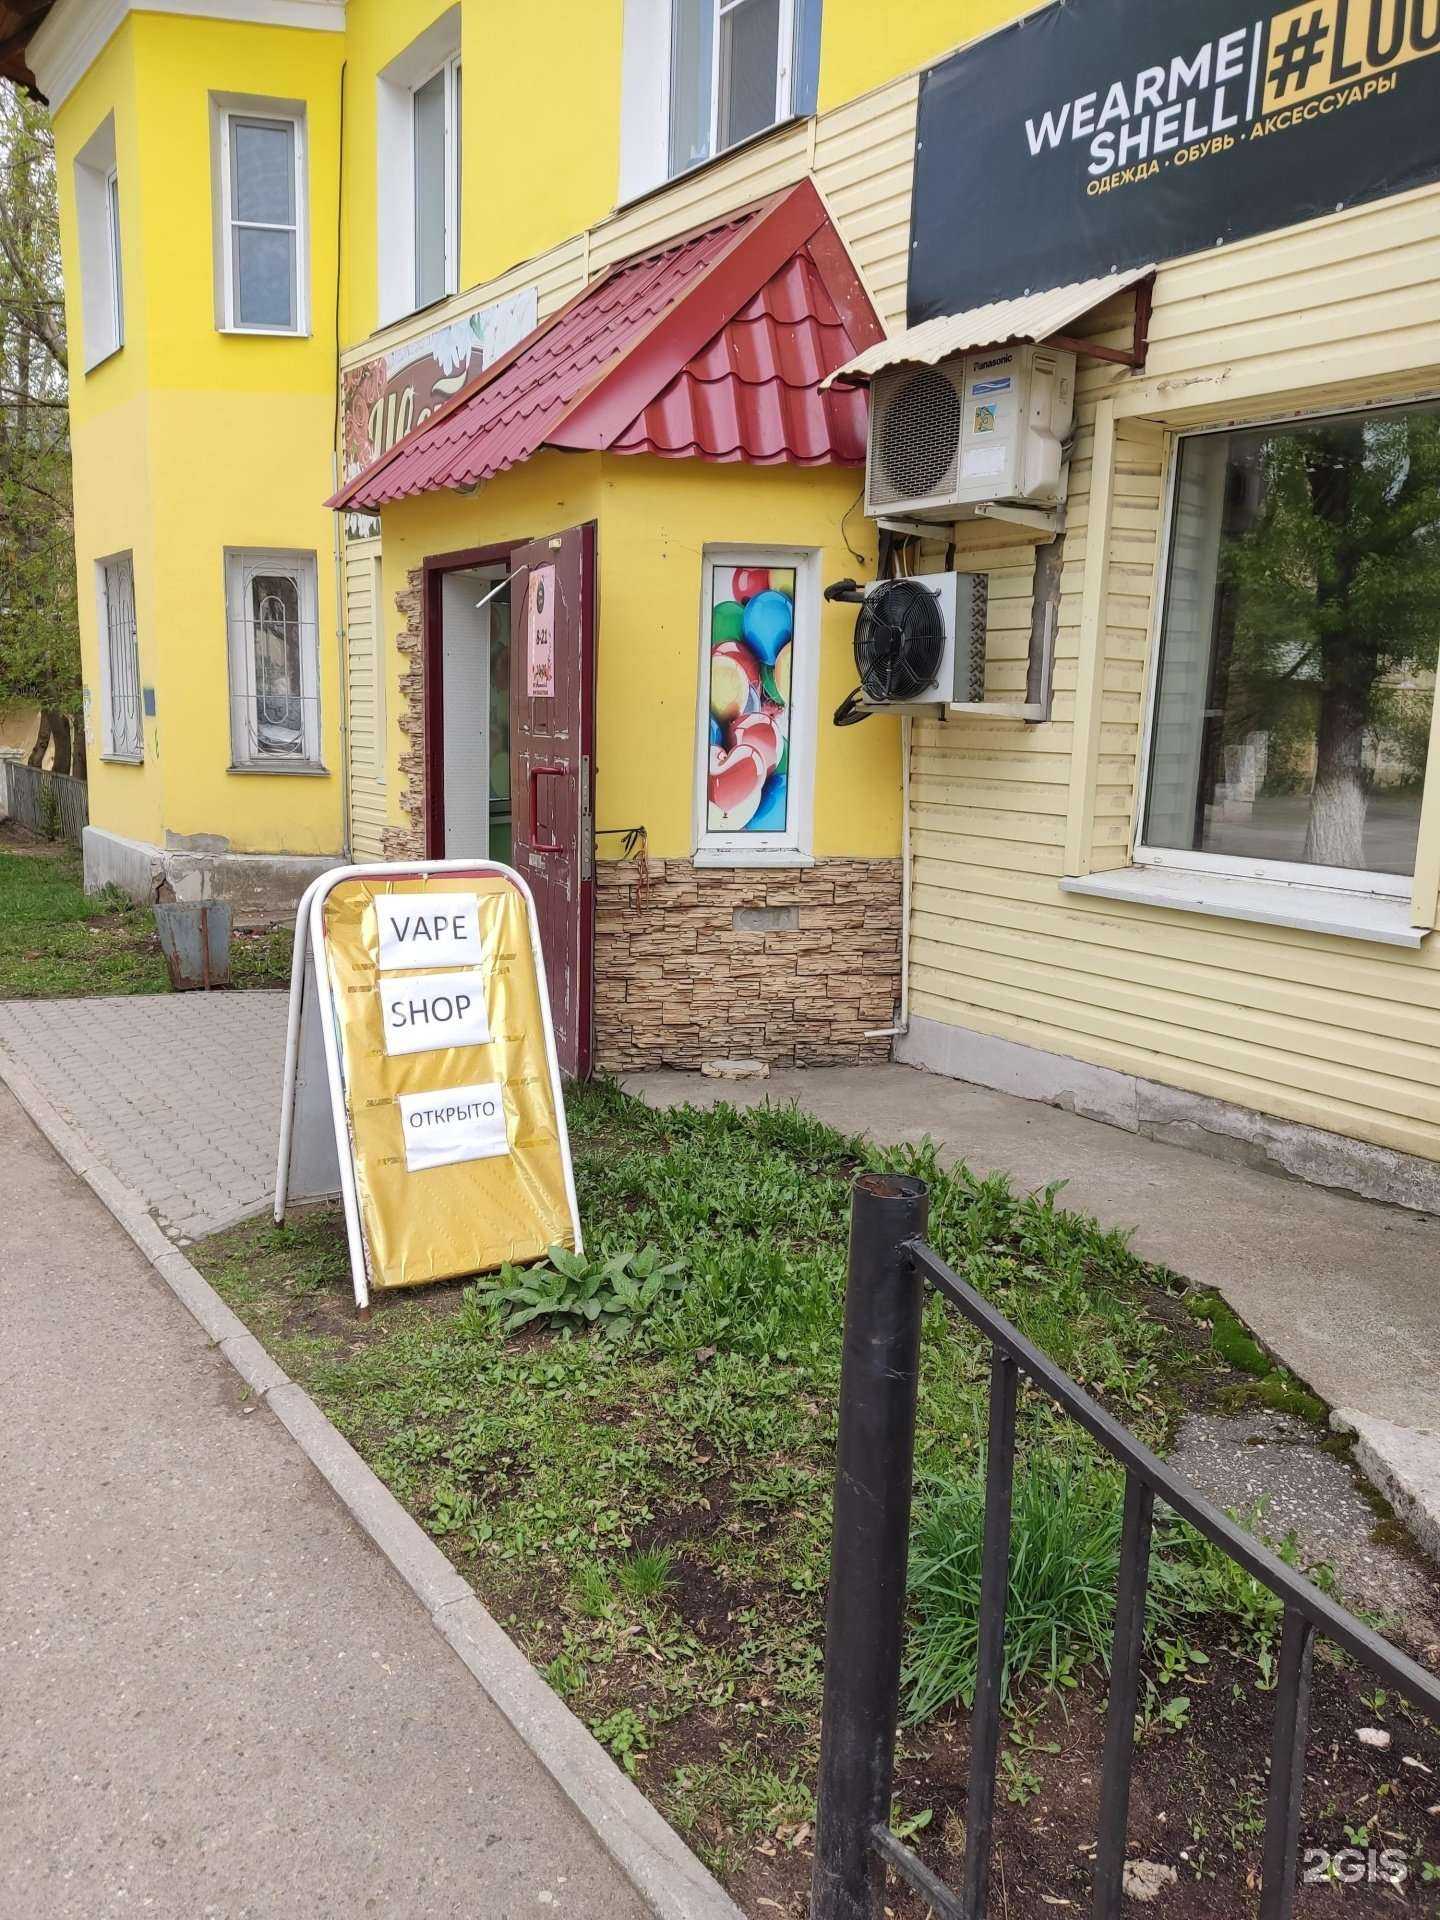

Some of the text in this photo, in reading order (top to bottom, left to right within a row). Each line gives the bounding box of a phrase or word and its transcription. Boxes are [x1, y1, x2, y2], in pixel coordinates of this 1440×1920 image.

[1025, 28, 1247, 156] WEARME
[1086, 72, 1398, 197] ОДЕЖДА ОБУВЬ АКСЕССУАРЫ
[1088, 83, 1240, 175] SHELL
[973, 353, 1013, 372] Panasonic
[390, 915, 468, 943] VAPE
[391, 994, 471, 1028] SHOP
[409, 1102, 495, 1129] ОТКРЫТО
